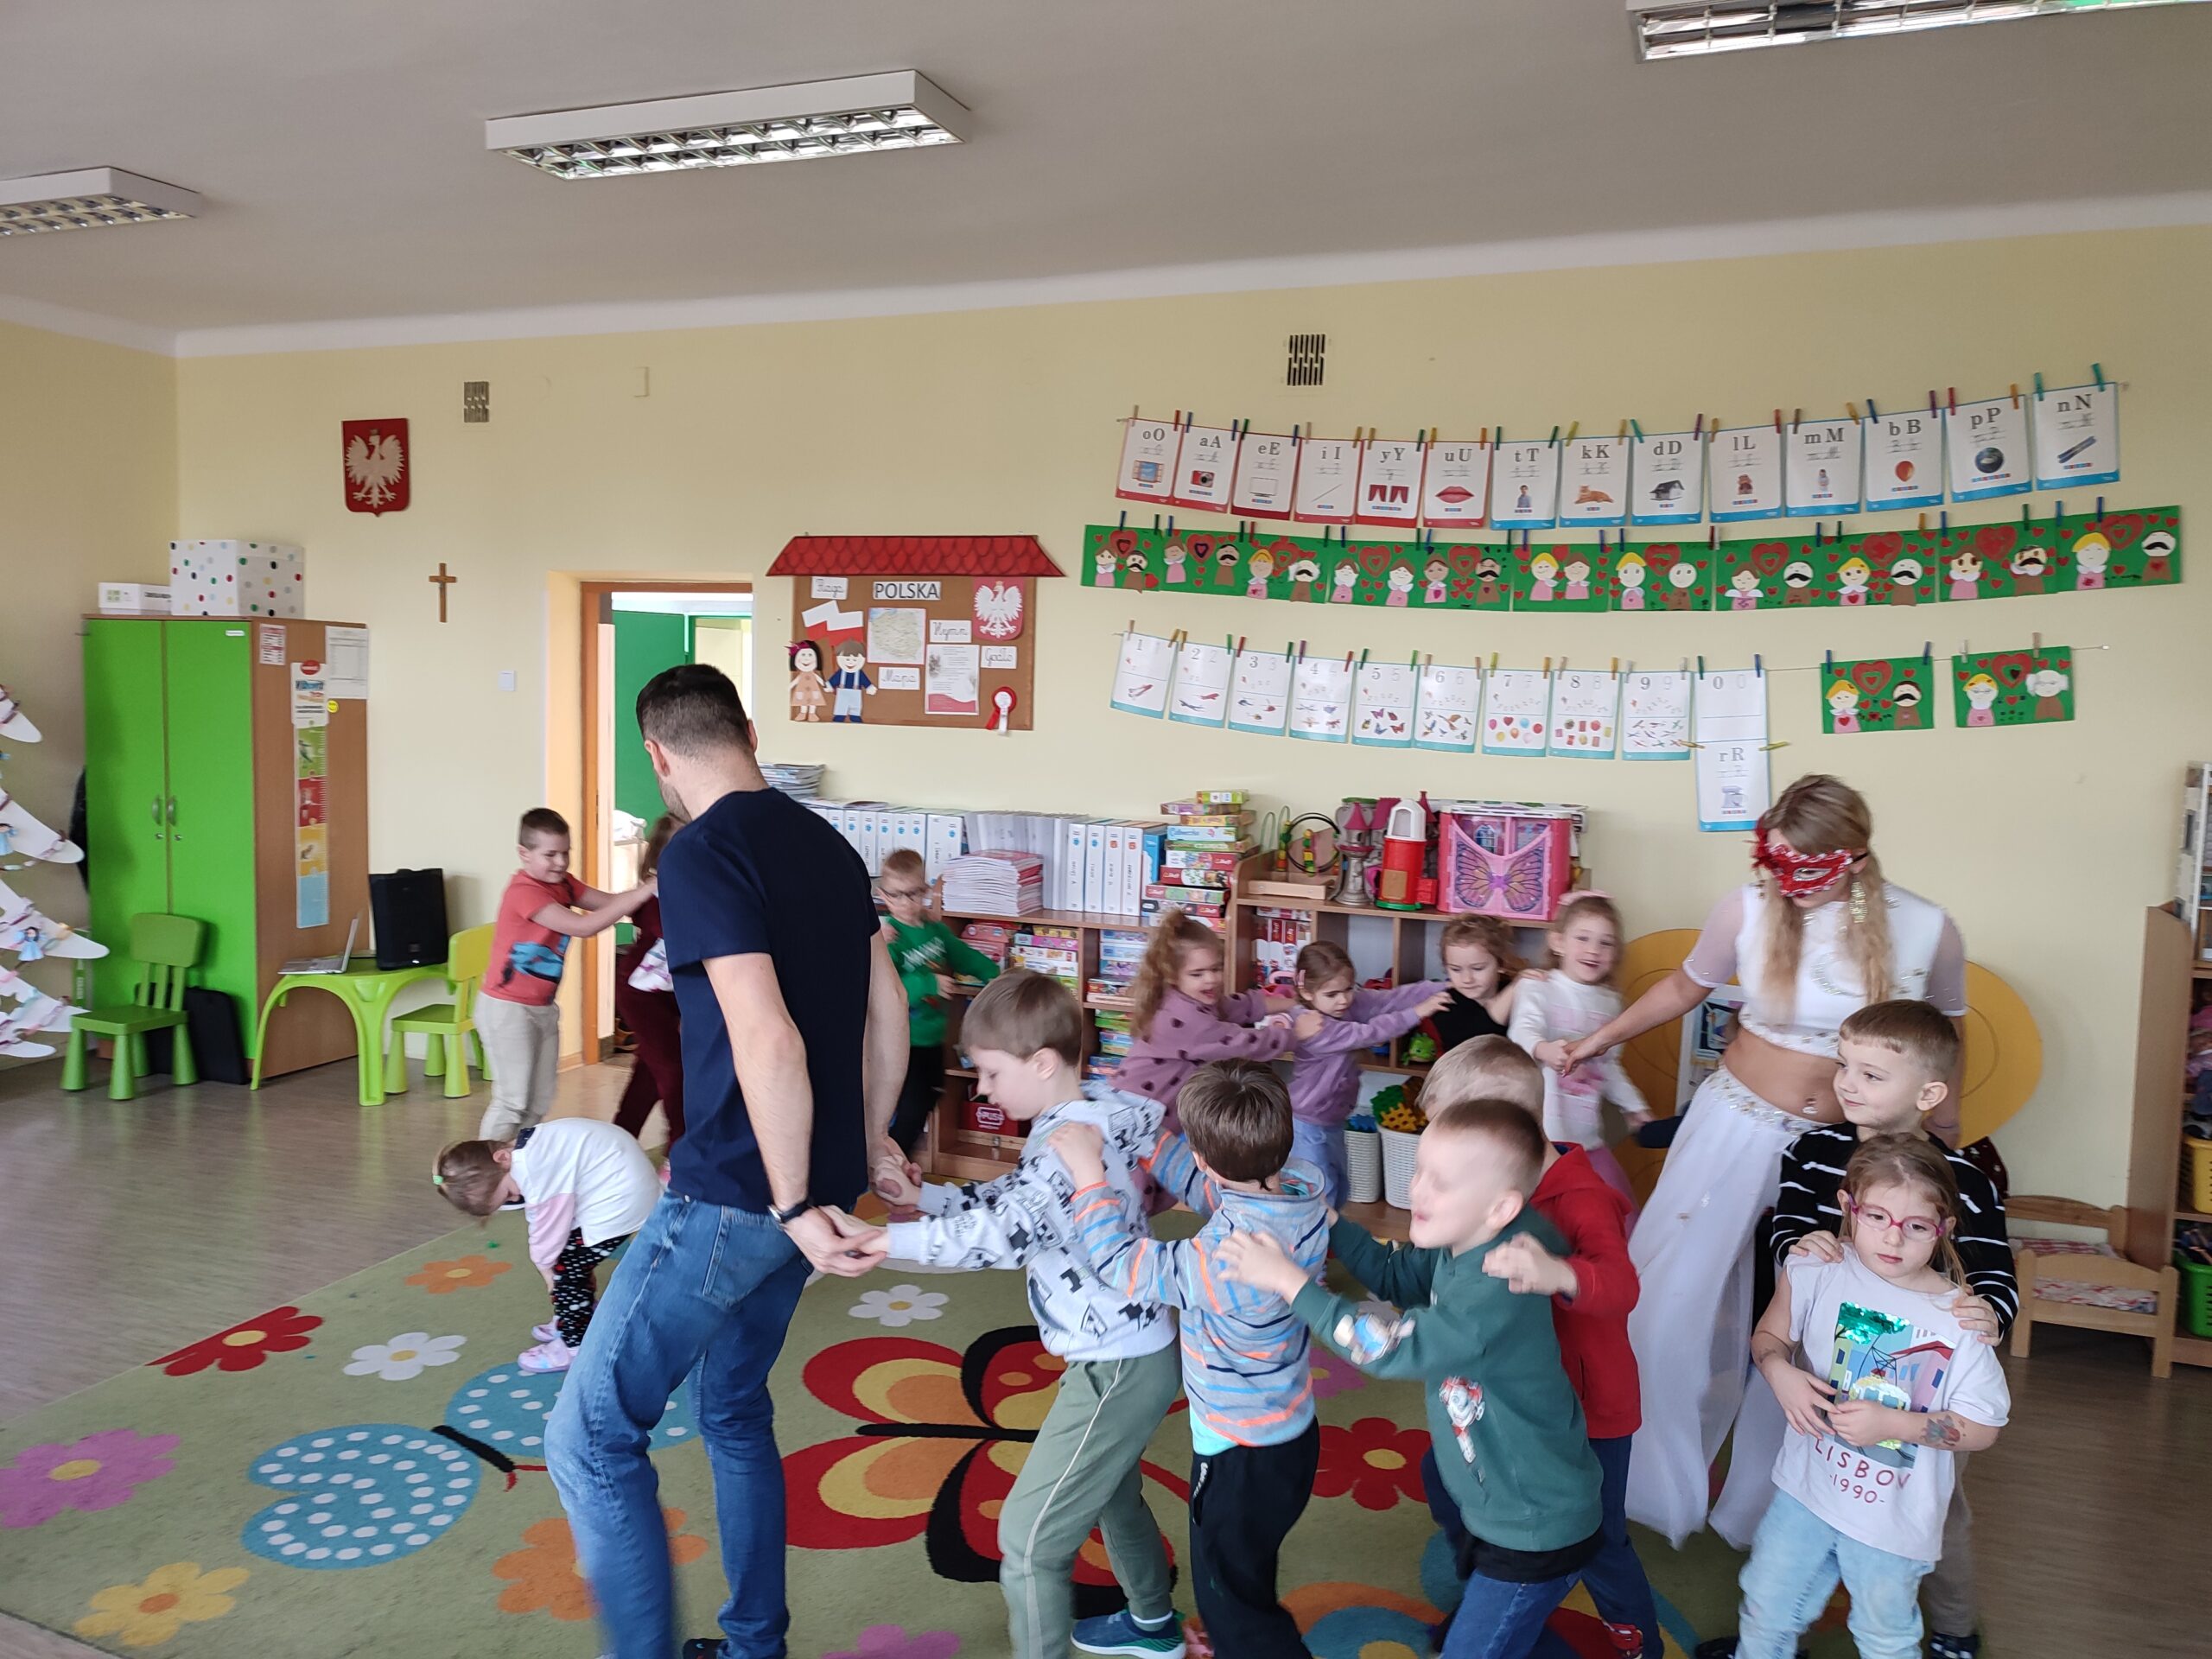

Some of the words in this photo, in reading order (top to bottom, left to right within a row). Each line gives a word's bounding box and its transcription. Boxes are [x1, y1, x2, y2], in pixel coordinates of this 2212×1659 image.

[875, 583, 939, 599] POLSKA
[1137, 639, 1143, 651] 1
[1192, 648, 1200, 660] 2
[1249, 656, 1258, 668] 3
[1310, 663, 1319, 675] 4
[1371, 667, 1381, 680] 5
[1435, 671, 1445, 683] 6
[1503, 674, 1512, 687] 7
[1571, 675, 1580, 689] 8
[1640, 677, 1650, 690] 9
[1713, 676, 1723, 690] 0
